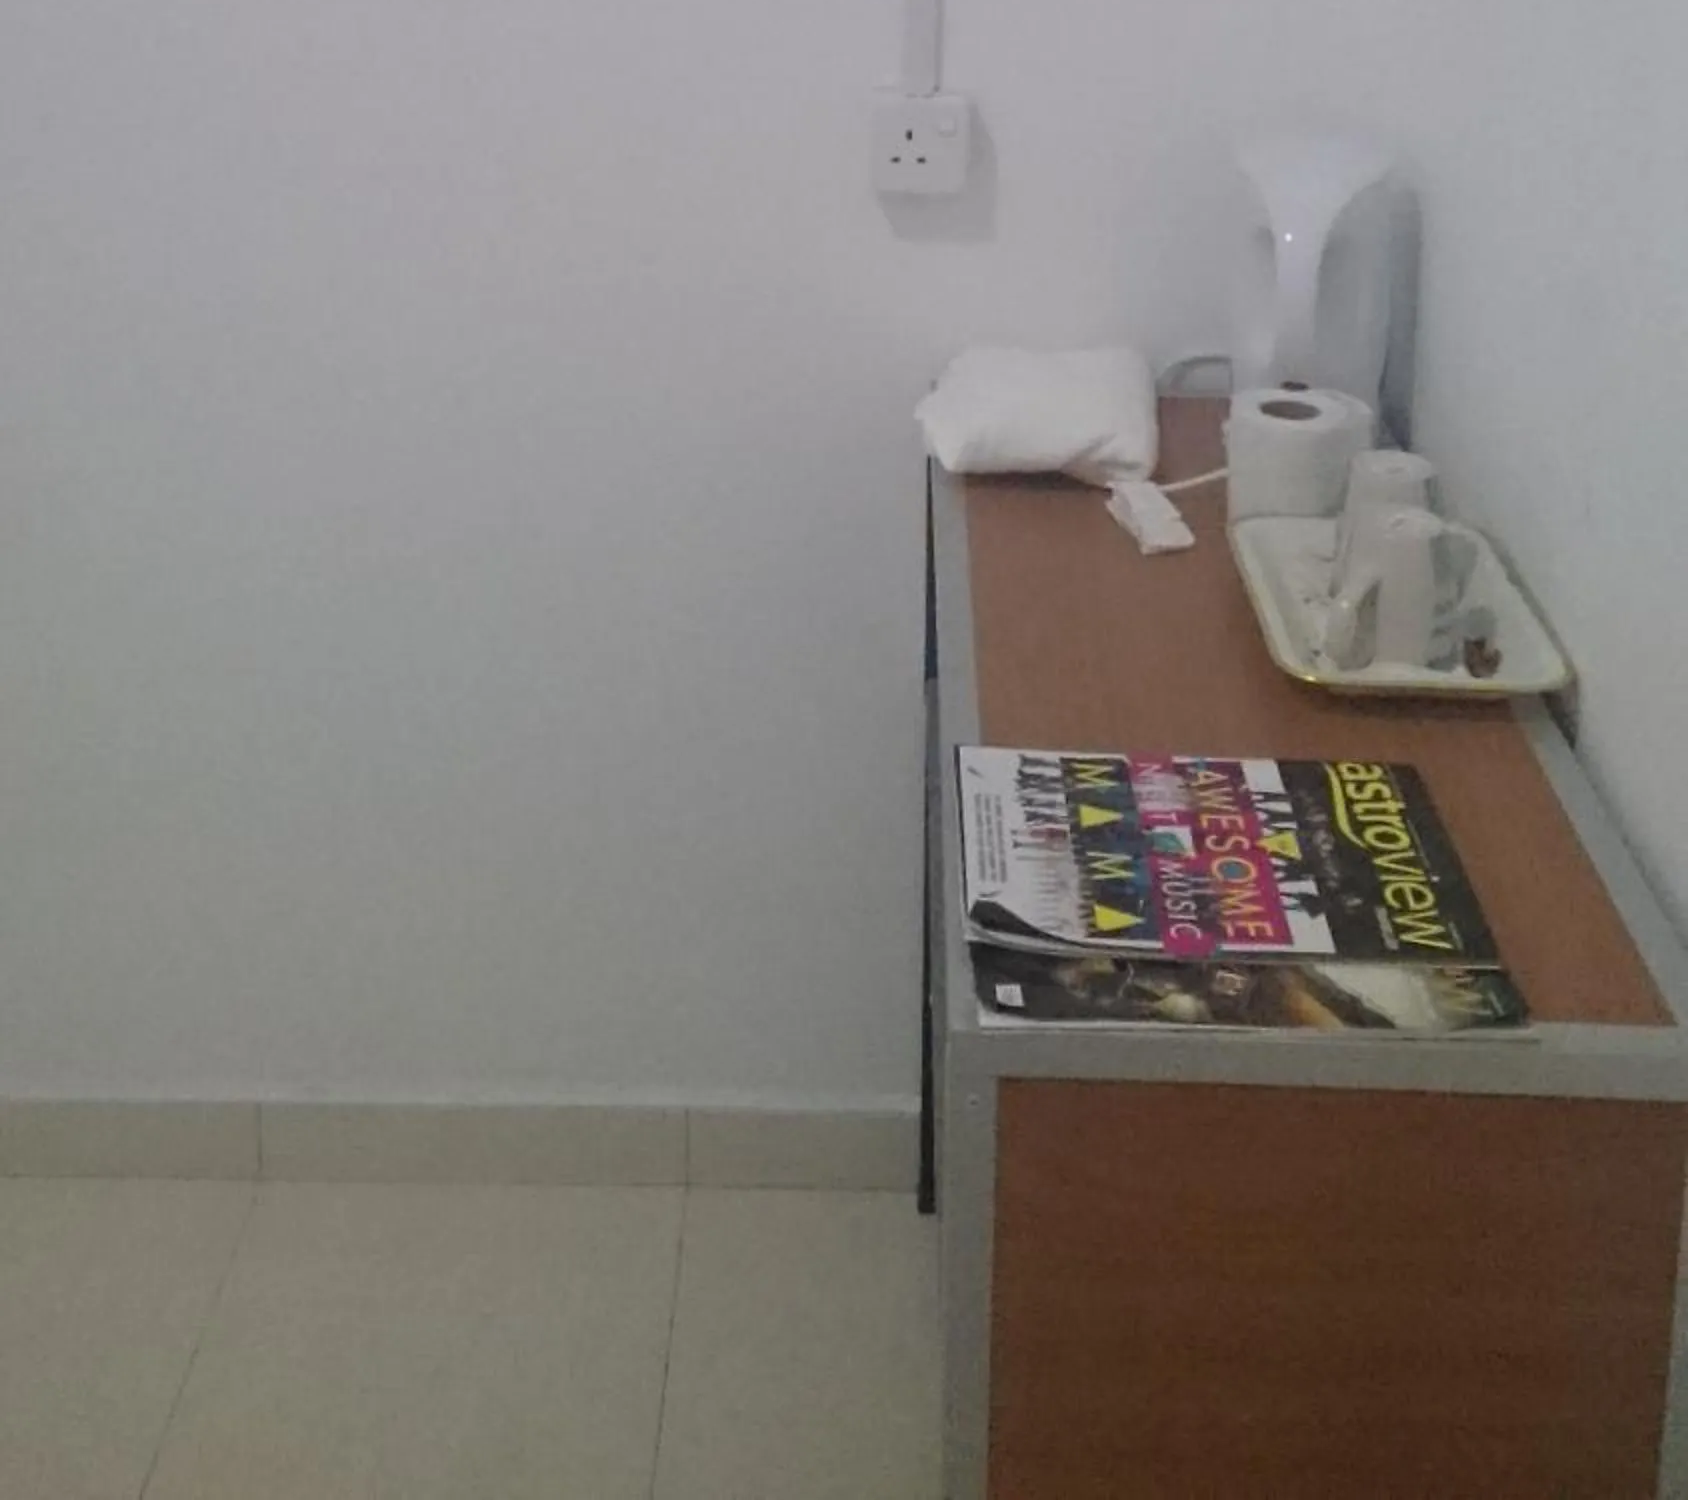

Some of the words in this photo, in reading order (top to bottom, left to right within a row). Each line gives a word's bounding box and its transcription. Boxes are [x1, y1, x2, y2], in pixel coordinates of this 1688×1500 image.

[1157, 859, 1203, 941] MUSIC
[1192, 771, 1273, 937] AWESOME
[1336, 763, 1453, 949] astroview
